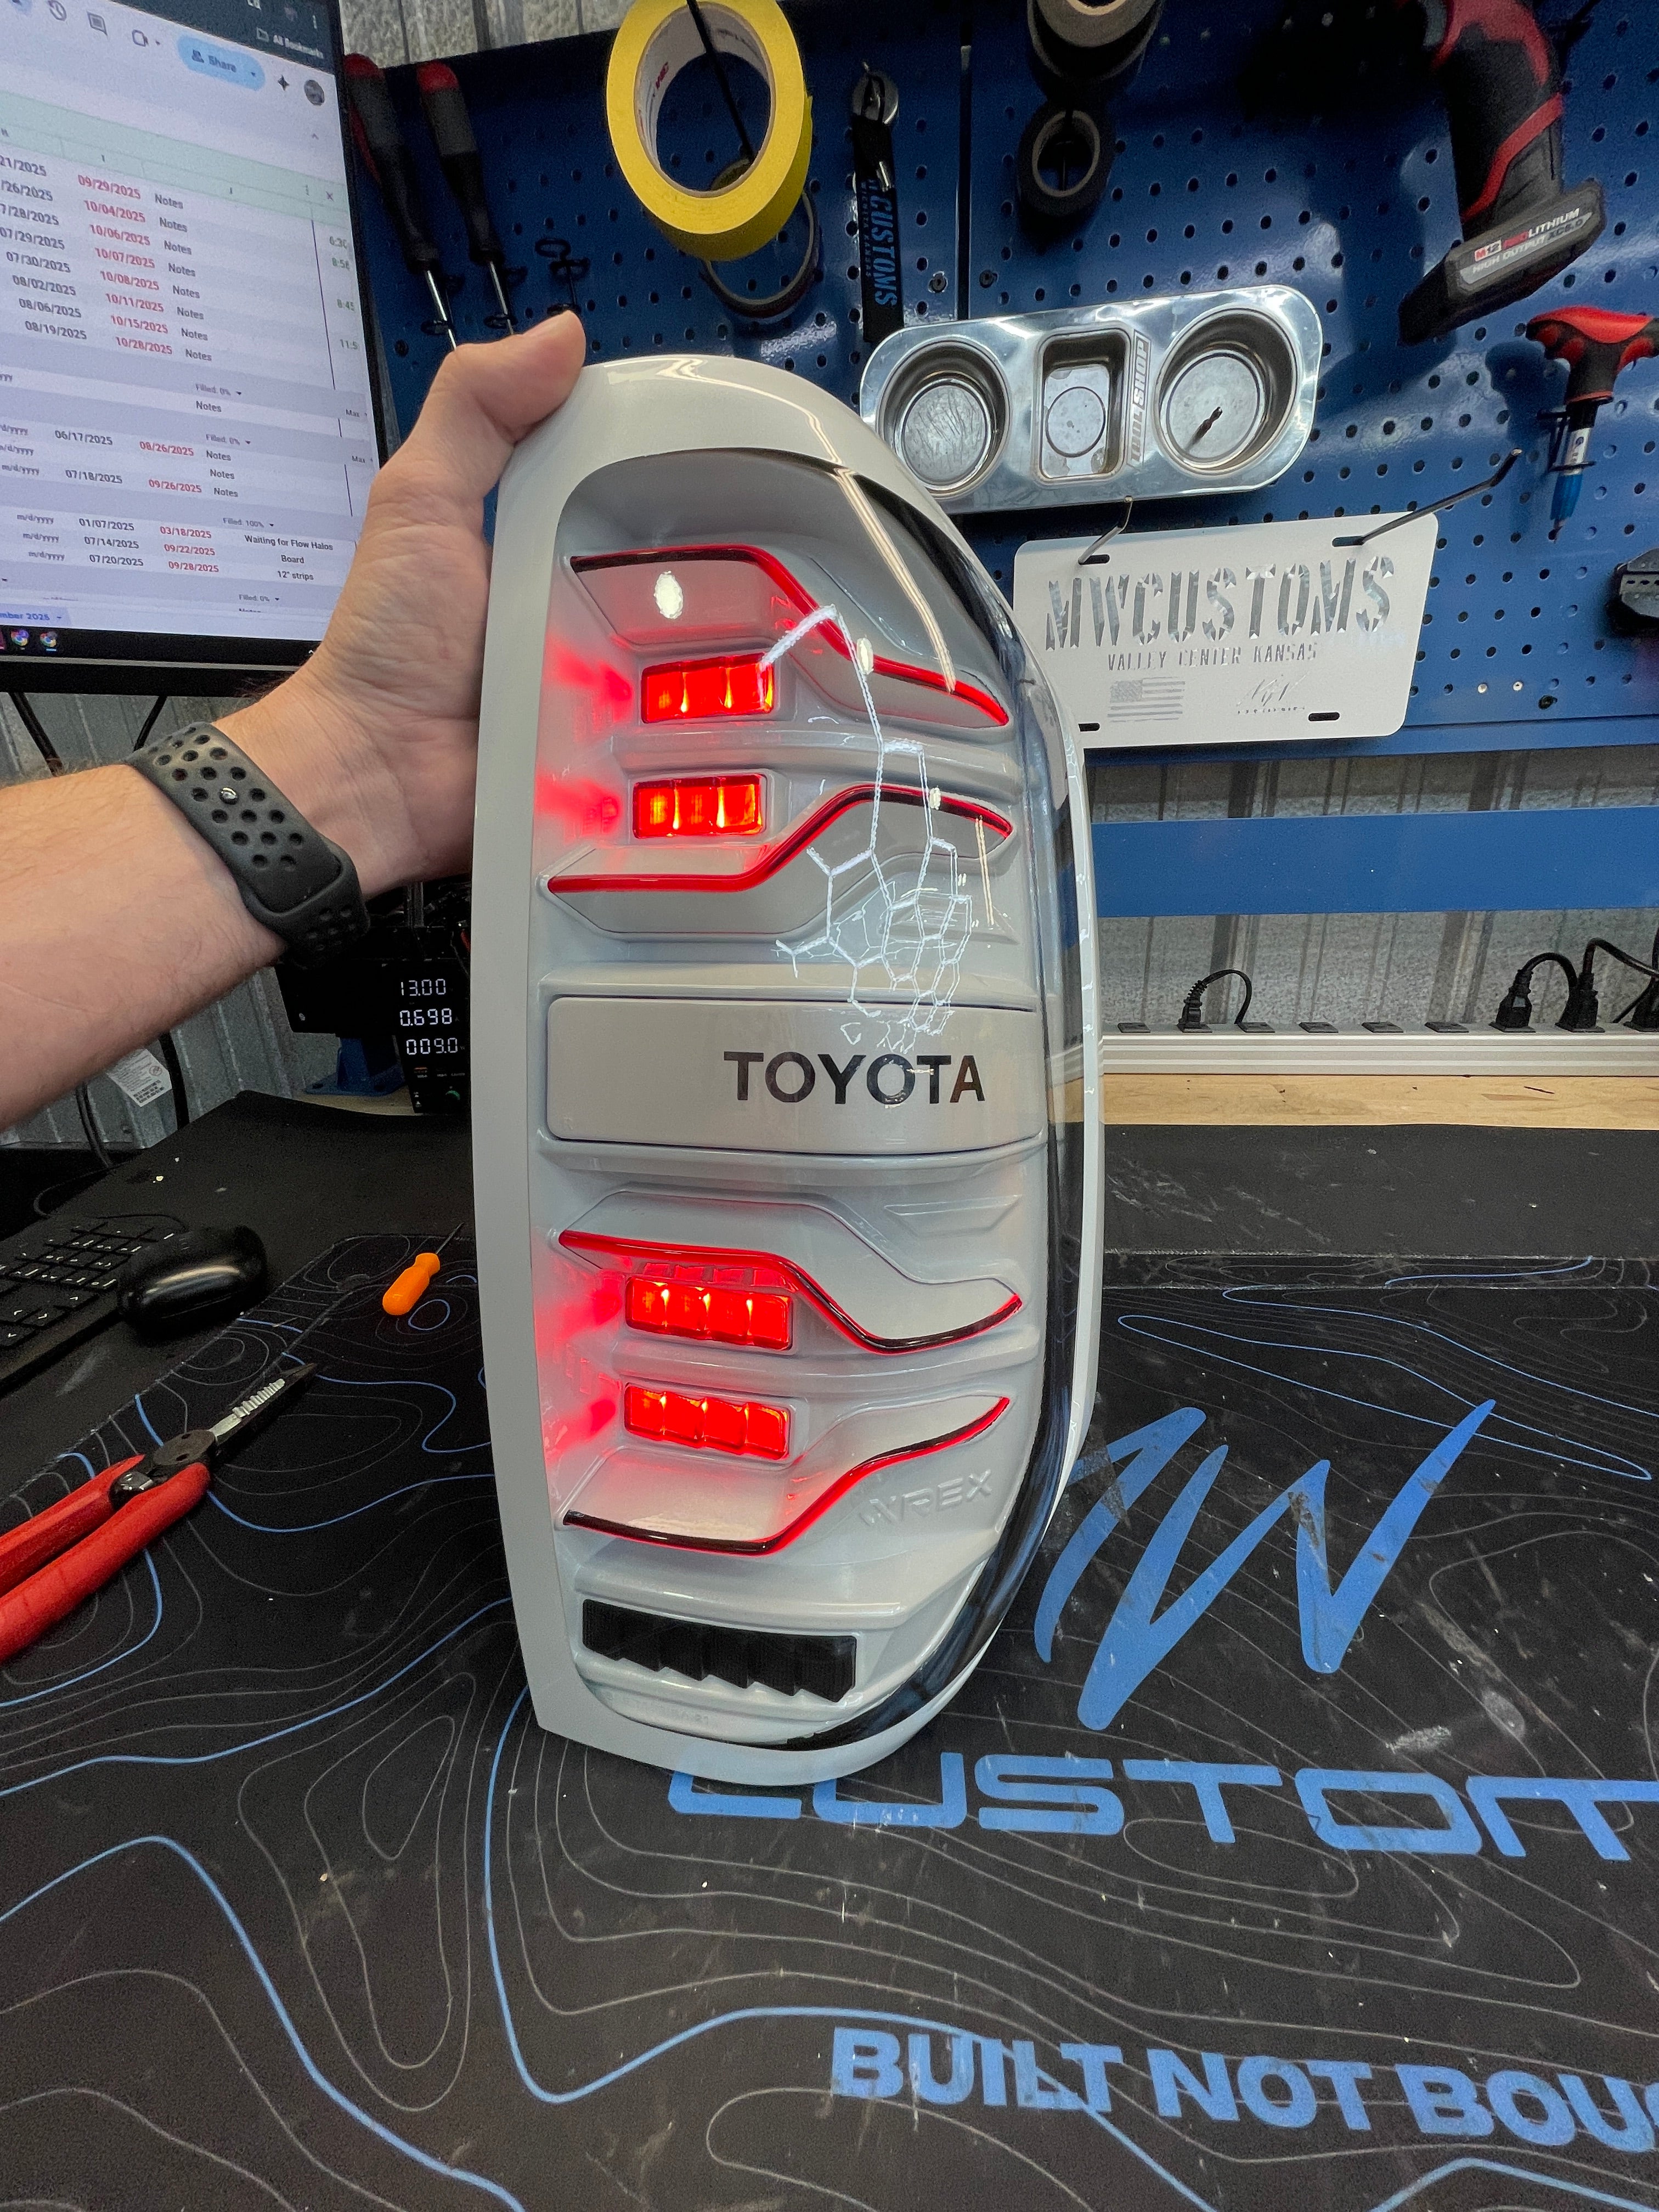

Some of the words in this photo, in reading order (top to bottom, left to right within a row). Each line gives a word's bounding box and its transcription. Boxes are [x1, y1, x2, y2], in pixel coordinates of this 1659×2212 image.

[208, 55, 236, 72] Share
[78, 174, 141, 199] 09/29/2025
[155, 193, 183, 209] Notes
[83, 200, 145, 222] 10/04/2025
[159, 217, 187, 233] Notes
[1528, 208, 1579, 238] LITHIUM
[0, 227, 65, 250] 07/29/2025
[95, 247, 155, 268] 10/07/2025
[168, 262, 196, 276] Notes
[89, 224, 150, 246] 10/06/2025
[164, 240, 191, 255] Notes
[6, 251, 71, 273] 07/30/2025
[100, 271, 159, 290] 10/08/2025
[172, 285, 200, 299] Notes
[12, 275, 76, 296] 08/02/2025
[105, 293, 164, 312] 10/11/2025
[177, 307, 204, 320] Notes
[19, 298, 82, 318] 08/06/2025
[111, 315, 168, 334] 10/15/2025
[181, 329, 208, 341] Notes
[25, 321, 87, 340] 08/19/2025
[116, 337, 172, 355] 10/28/2025
[185, 349, 212, 362] Notes
[1133, 339, 1147, 407] SHOP
[196, 400, 222, 412] Notes
[55, 430, 113, 445] 06/17/2025
[139, 441, 194, 456] 08/26/2025
[206, 450, 231, 461] Notes
[65, 469, 123, 484] 07/18/2025
[149, 479, 202, 493] 09/26/2025
[214, 488, 238, 497] Notes
[210, 469, 235, 479] Notes
[17, 514, 54, 524] m/d/yyyy
[79, 518, 134, 531] 01/07/2025
[160, 526, 212, 539] 03/18/2025
[245, 534, 275, 546] Waiting
[278, 538, 289, 546] for
[291, 539, 309, 549] Flow
[311, 541, 333, 551] Halos
[23, 533, 59, 543] m/d/yyyy
[84, 536, 139, 549] 07/14/2025
[164, 544, 216, 556] 09/22/2025
[281, 555, 304, 564] Board
[29, 551, 65, 561] m/d/yyyy
[89, 554, 144, 566] 07/20/2025
[168, 561, 219, 573] 09/28/2025
[292, 572, 314, 580] strips
[1046, 556, 1394, 651] MWCUSTOMS
[1108, 651, 1167, 670] VALLEY
[1179, 647, 1241, 667] CENTER
[1254, 642, 1317, 663] KANSAS
[400, 979, 446, 996] 13.00
[399, 1008, 452, 1026] 0.698
[406, 1037, 458, 1055] 009.0
[724, 1051, 985, 1105] TOYOTA
[821, 2027, 1123, 2112] BUILT
[1147, 2048, 1372, 2130] NOT
[1395, 2064, 1659, 2152] BOU
